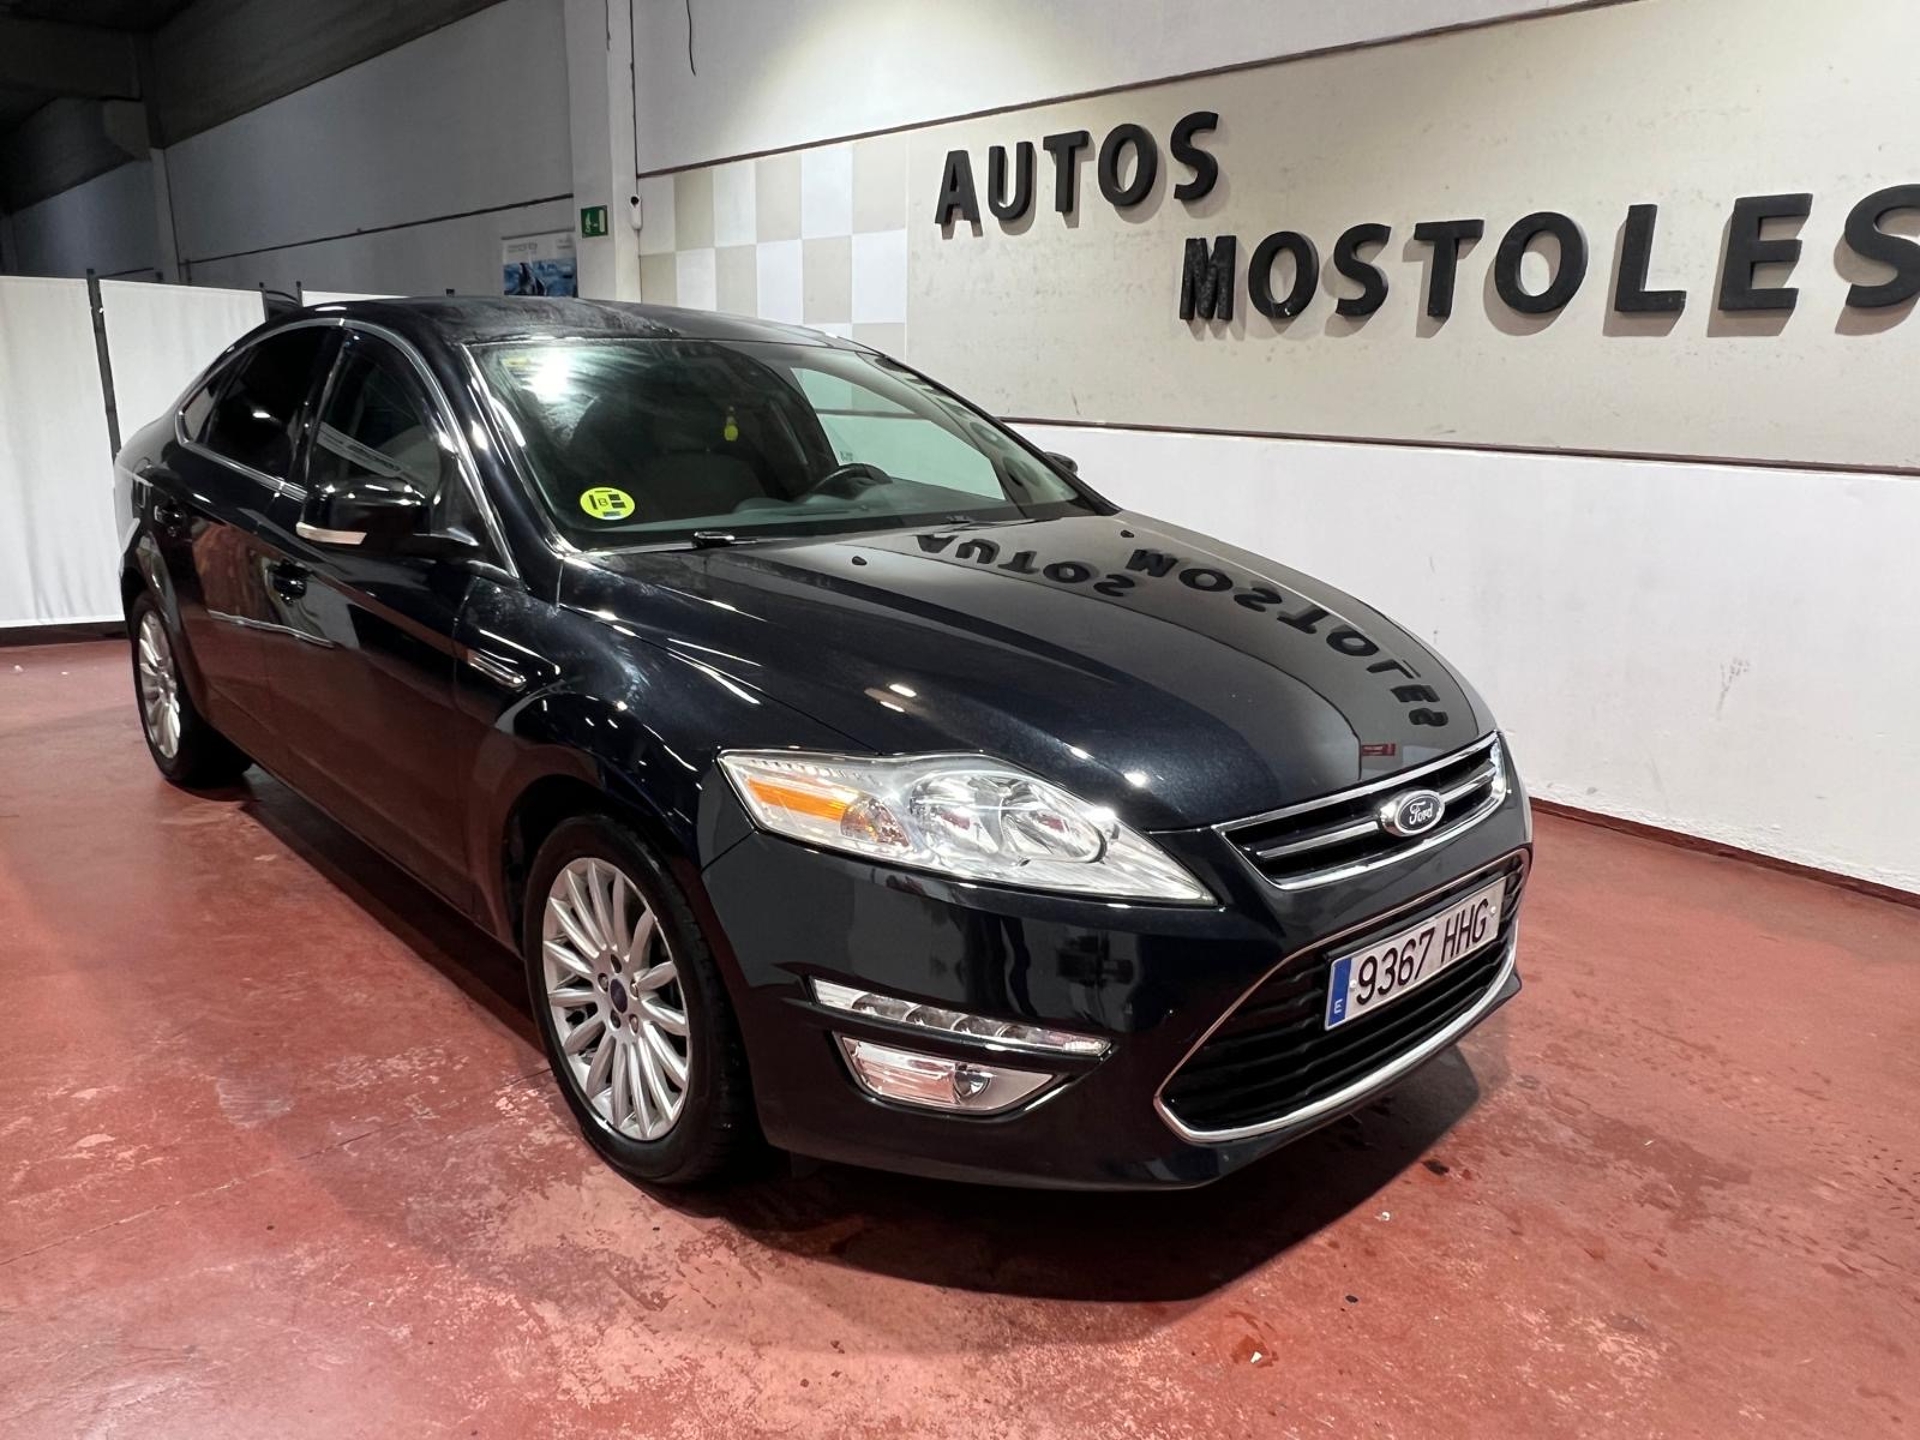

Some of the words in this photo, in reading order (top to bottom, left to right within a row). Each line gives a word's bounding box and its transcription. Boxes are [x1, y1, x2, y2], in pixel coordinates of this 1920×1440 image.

[934, 110, 1219, 224] AUTOS
[1179, 183, 1920, 321] MOSTOLES
[1408, 800, 1434, 825] Ford
[1333, 998, 1343, 1014] E
[1356, 926, 1436, 1006] 9367
[1440, 898, 1489, 966] HHG
